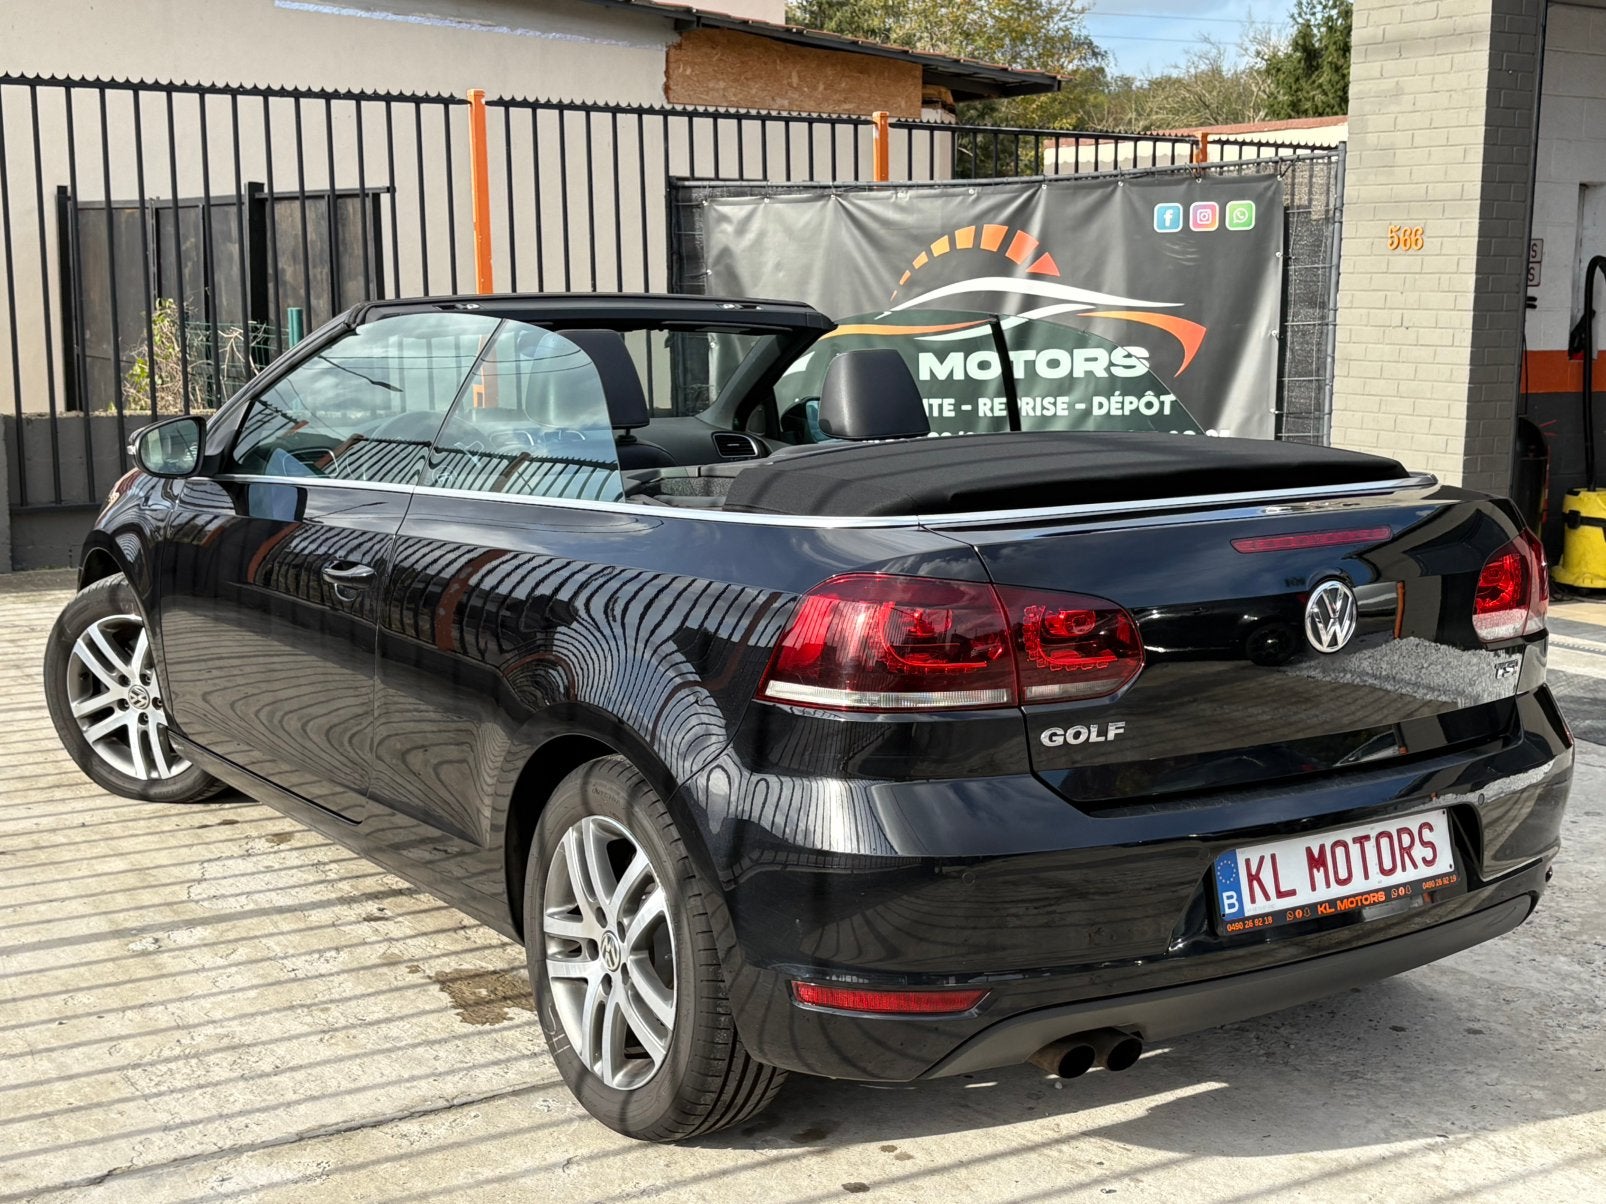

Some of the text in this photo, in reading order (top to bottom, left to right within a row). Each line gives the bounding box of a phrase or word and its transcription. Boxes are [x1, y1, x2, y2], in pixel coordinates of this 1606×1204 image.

[1387, 224, 1425, 251] 566
[918, 345, 1150, 381] MOTORS
[977, 395, 1070, 417] RERISE
[1092, 390, 1177, 416] DÉPÔT
[1040, 721, 1126, 747] GOLF
[1244, 821, 1438, 905] KL MOTORS
[1222, 890, 1240, 915] B
[1317, 891, 1386, 915] KL MOTORS
